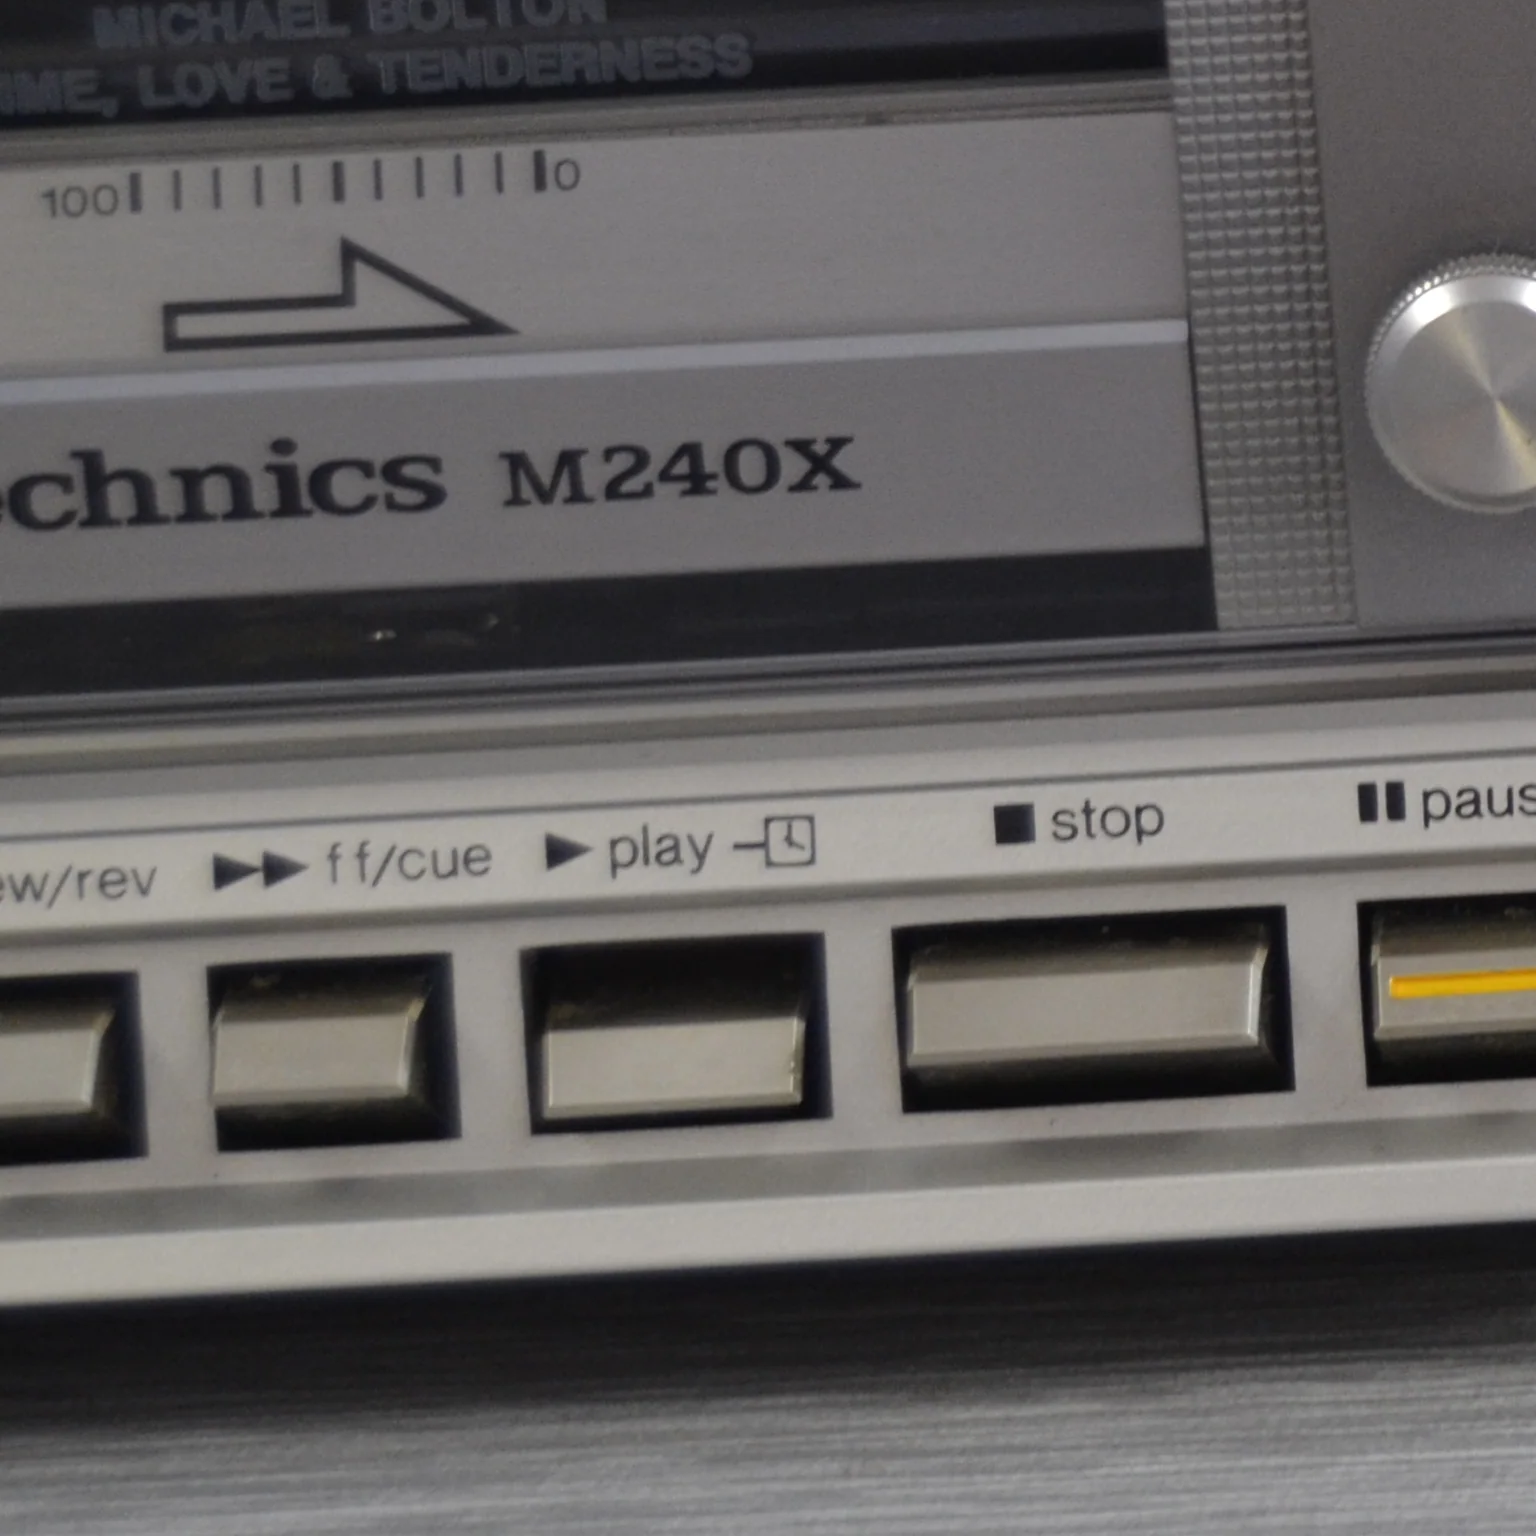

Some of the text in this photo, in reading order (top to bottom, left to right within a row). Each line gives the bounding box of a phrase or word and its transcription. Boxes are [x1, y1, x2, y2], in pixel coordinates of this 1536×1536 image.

[136, 54, 294, 111] LOVE
[310, 55, 353, 103] &
[375, 31, 756, 94] TENDERNESS
[39, 181, 119, 221] 100
[0, 435, 863, 533] chnics M240X
[1050, 798, 1166, 846] stop
[325, 837, 493, 886] ff/cue
[607, 823, 715, 881] play
